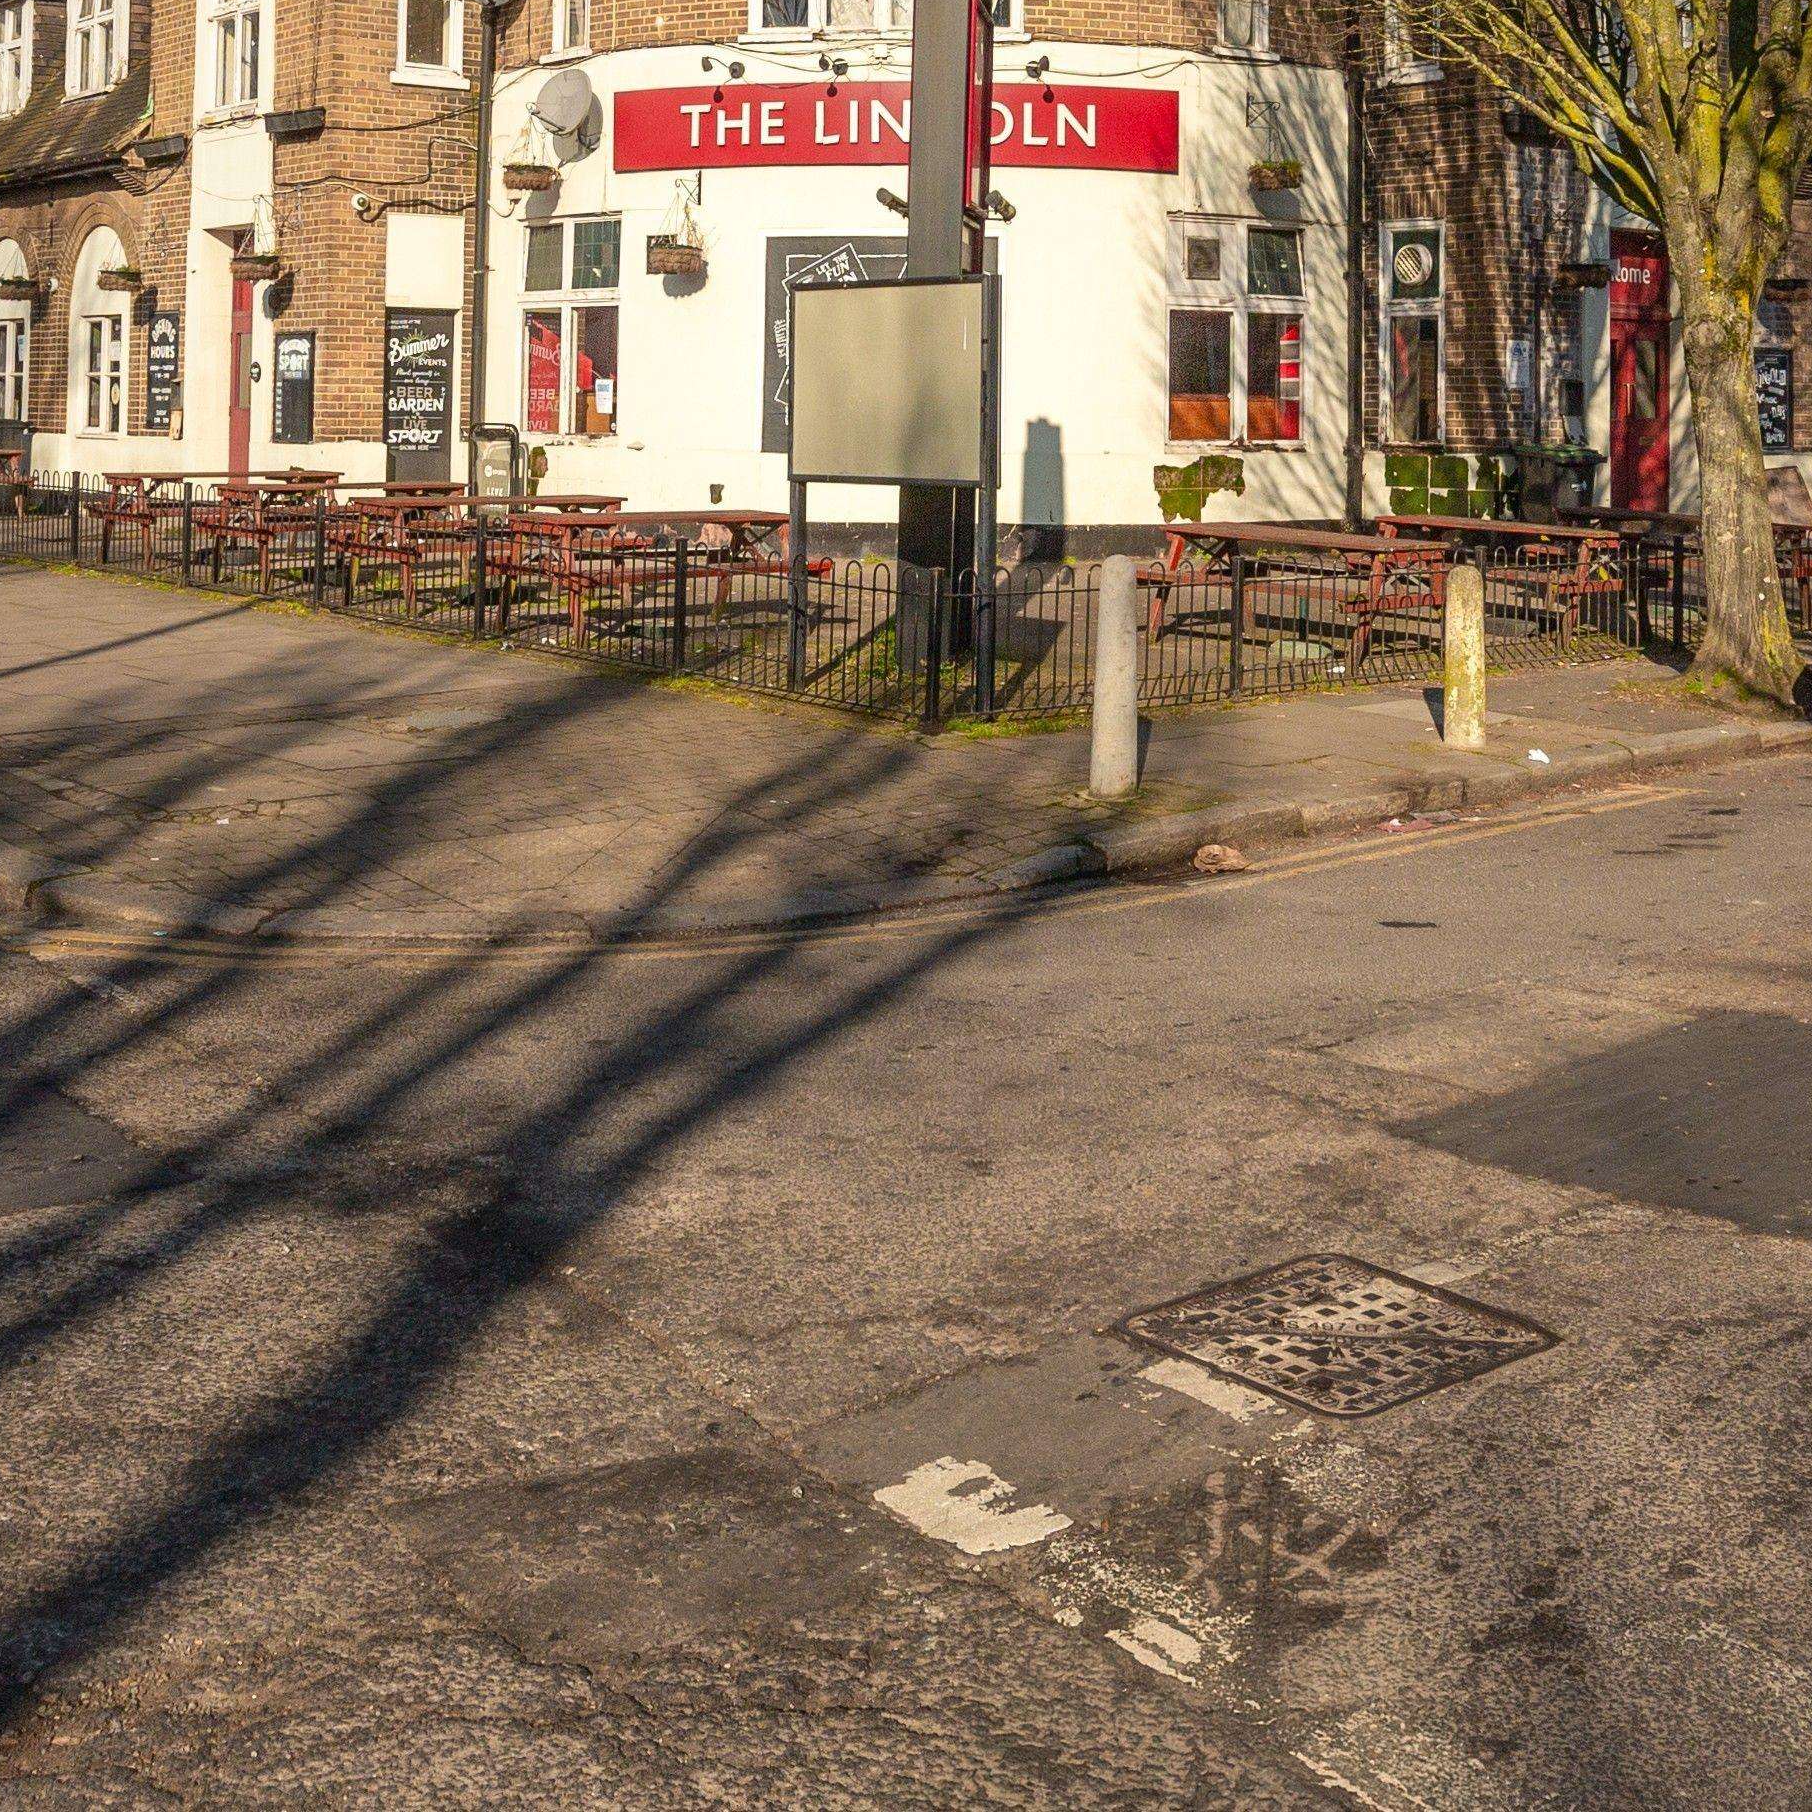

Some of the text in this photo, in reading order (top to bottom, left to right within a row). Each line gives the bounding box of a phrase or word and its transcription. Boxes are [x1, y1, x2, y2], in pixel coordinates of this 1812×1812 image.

[679, 99, 1098, 149] THE LINOLN
[388, 333, 450, 367] Summer
[418, 357, 448, 367] EVENTS
[396, 386, 433, 399] BEER
[388, 397, 444, 412] GARDEN
[403, 419, 428, 430] LIVE
[387, 428, 444, 444] SPORT
